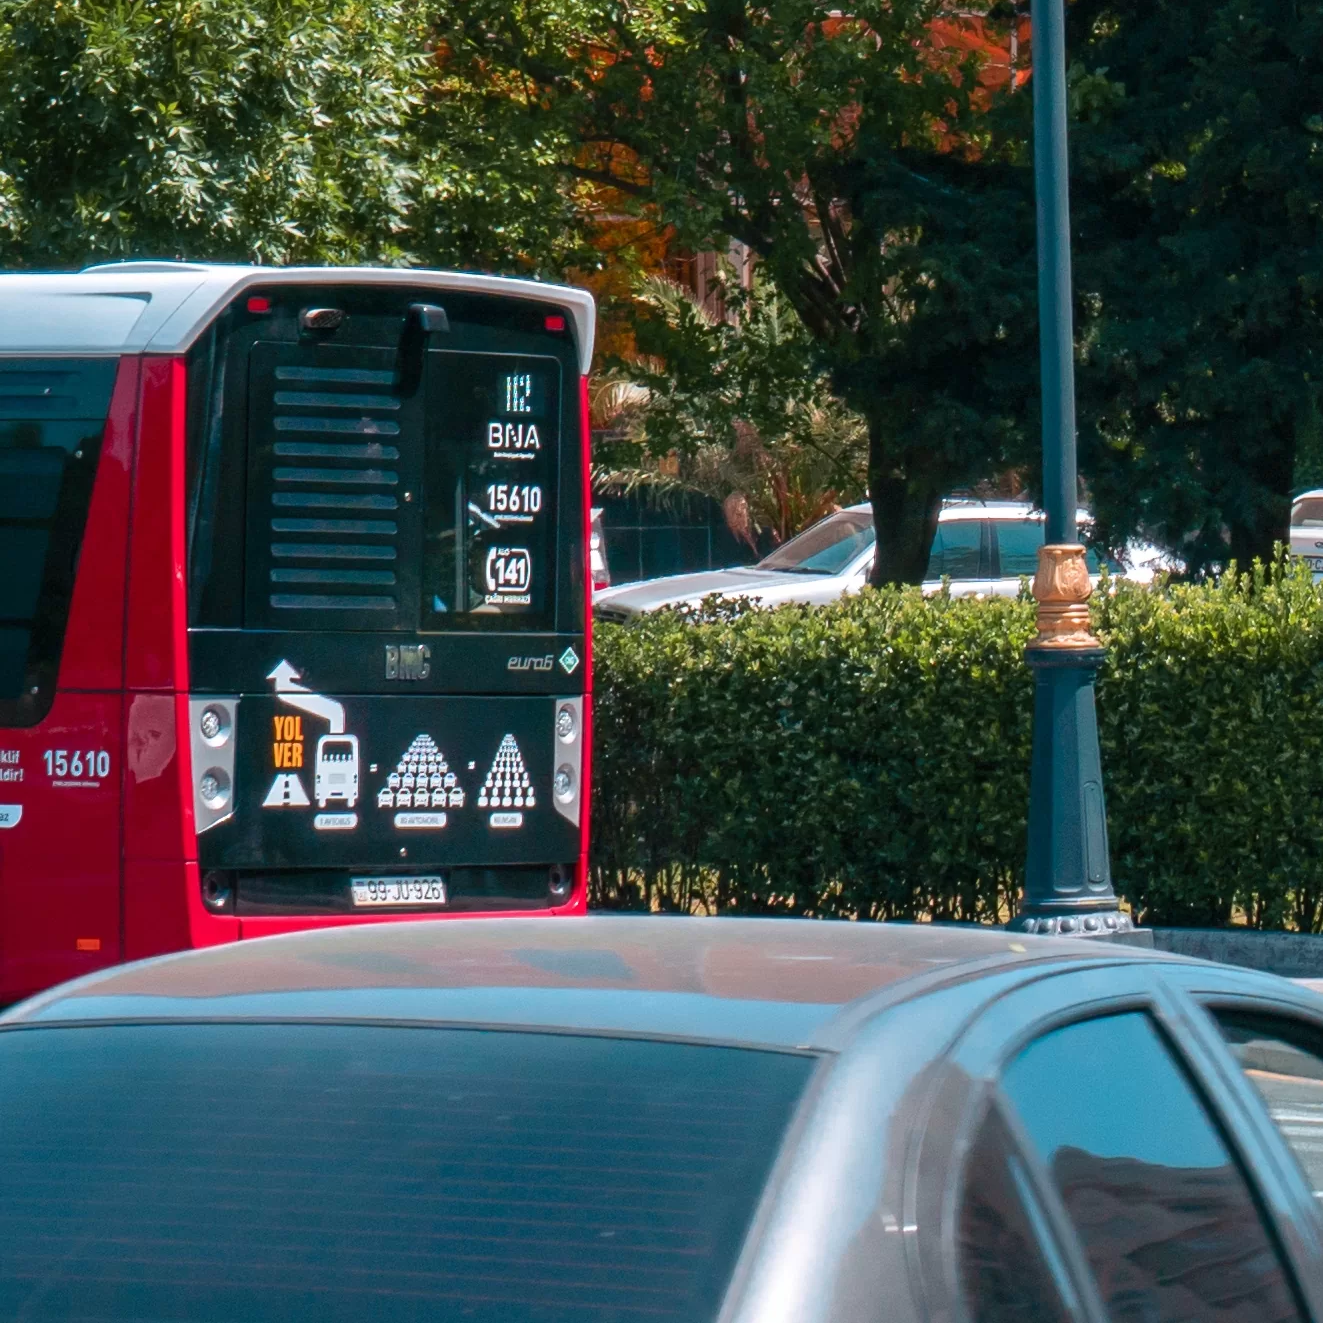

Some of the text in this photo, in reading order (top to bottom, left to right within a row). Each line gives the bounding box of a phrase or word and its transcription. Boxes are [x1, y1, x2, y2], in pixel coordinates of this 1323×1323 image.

[488, 422, 540, 449] BNA
[487, 484, 541, 512] 15610
[495, 557, 526, 585] 141
[385, 644, 431, 680] BMC
[273, 715, 304, 741] YOL
[0, 749, 20, 764] klif
[43, 749, 110, 778] 15610
[274, 742, 303, 768] VER
